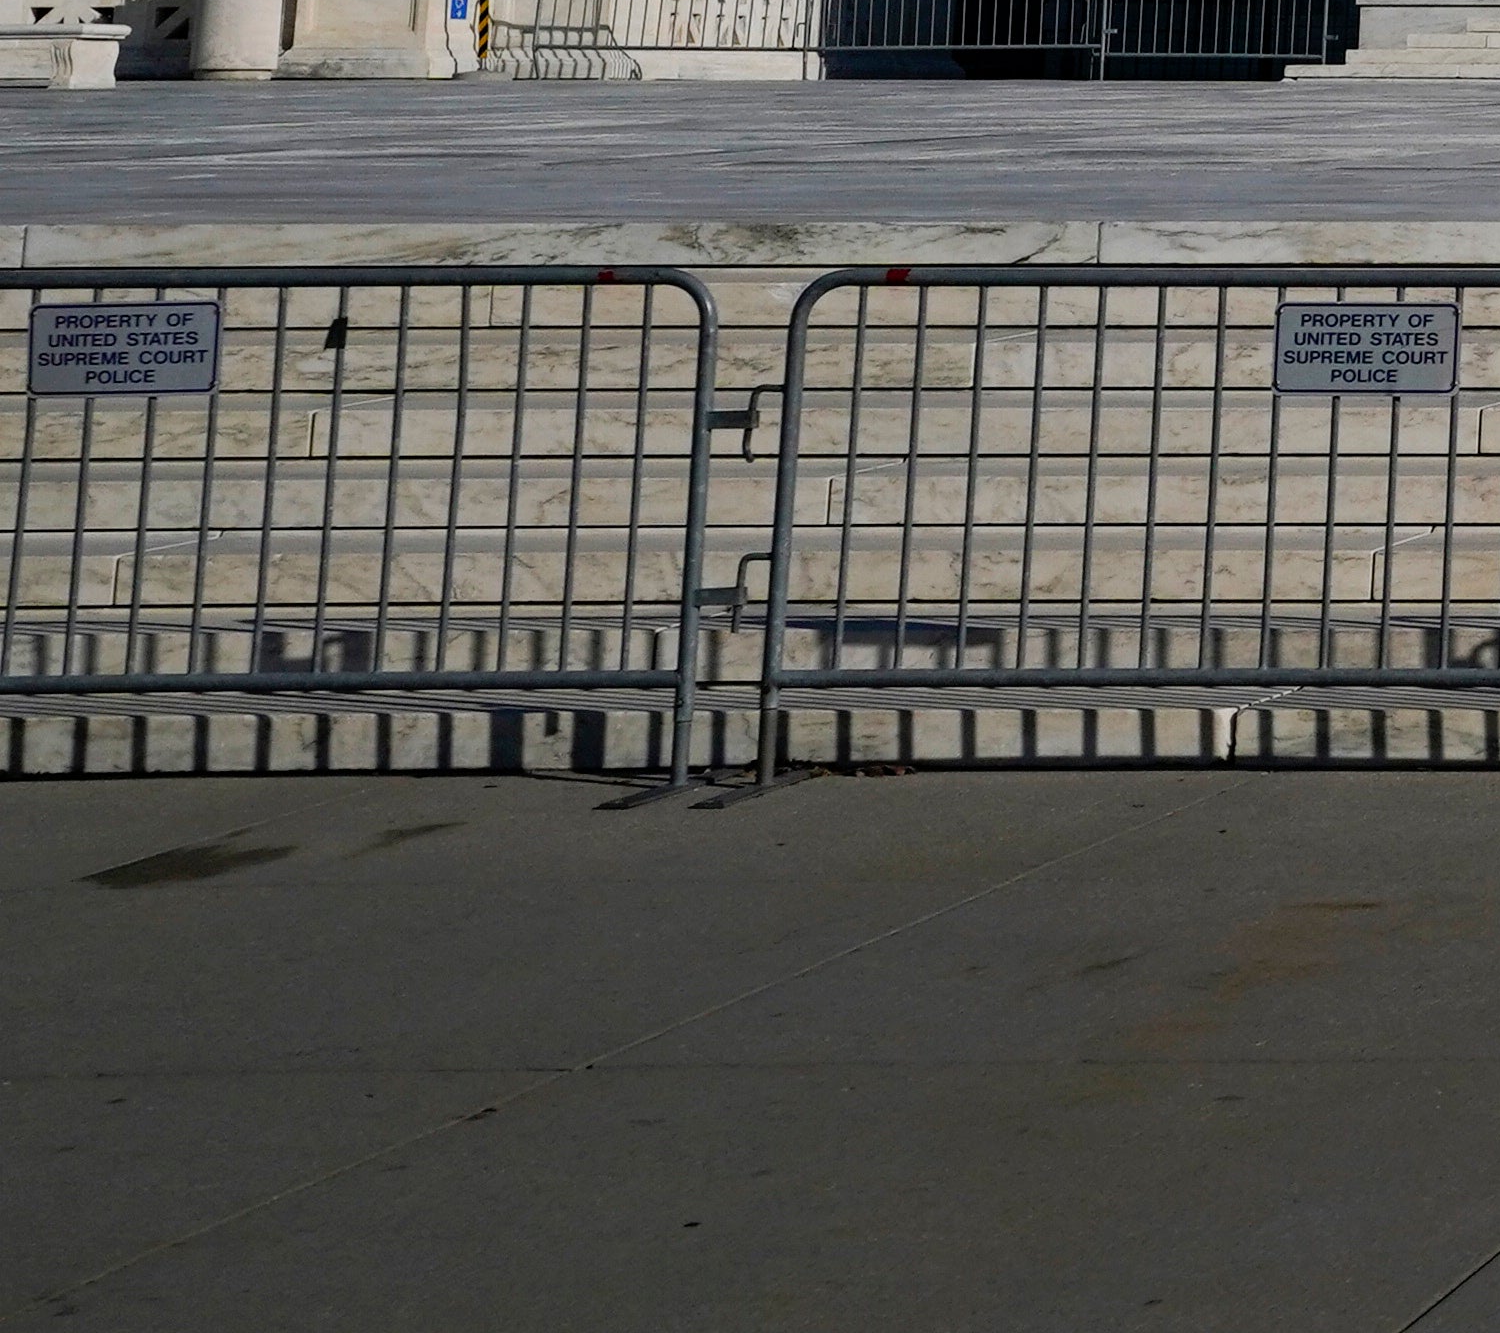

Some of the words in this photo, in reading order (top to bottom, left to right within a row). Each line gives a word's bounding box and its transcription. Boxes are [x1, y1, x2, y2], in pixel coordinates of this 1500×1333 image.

[55, 314, 158, 329] PROPERTY
[166, 313, 194, 327] OF
[1300, 313, 1400, 328] PROPERTY
[1408, 314, 1434, 328] OF
[48, 333, 117, 347] UNITED
[126, 331, 199, 346] STATES
[1294, 332, 1361, 346] UNITED
[1370, 332, 1439, 346] STATES
[38, 351, 129, 366] SUPREME
[138, 349, 209, 365] COURT
[1283, 350, 1373, 364] SUPREME
[1381, 350, 1448, 364] COURT
[85, 369, 156, 384] POLICE
[1330, 369, 1398, 383] POLICE
